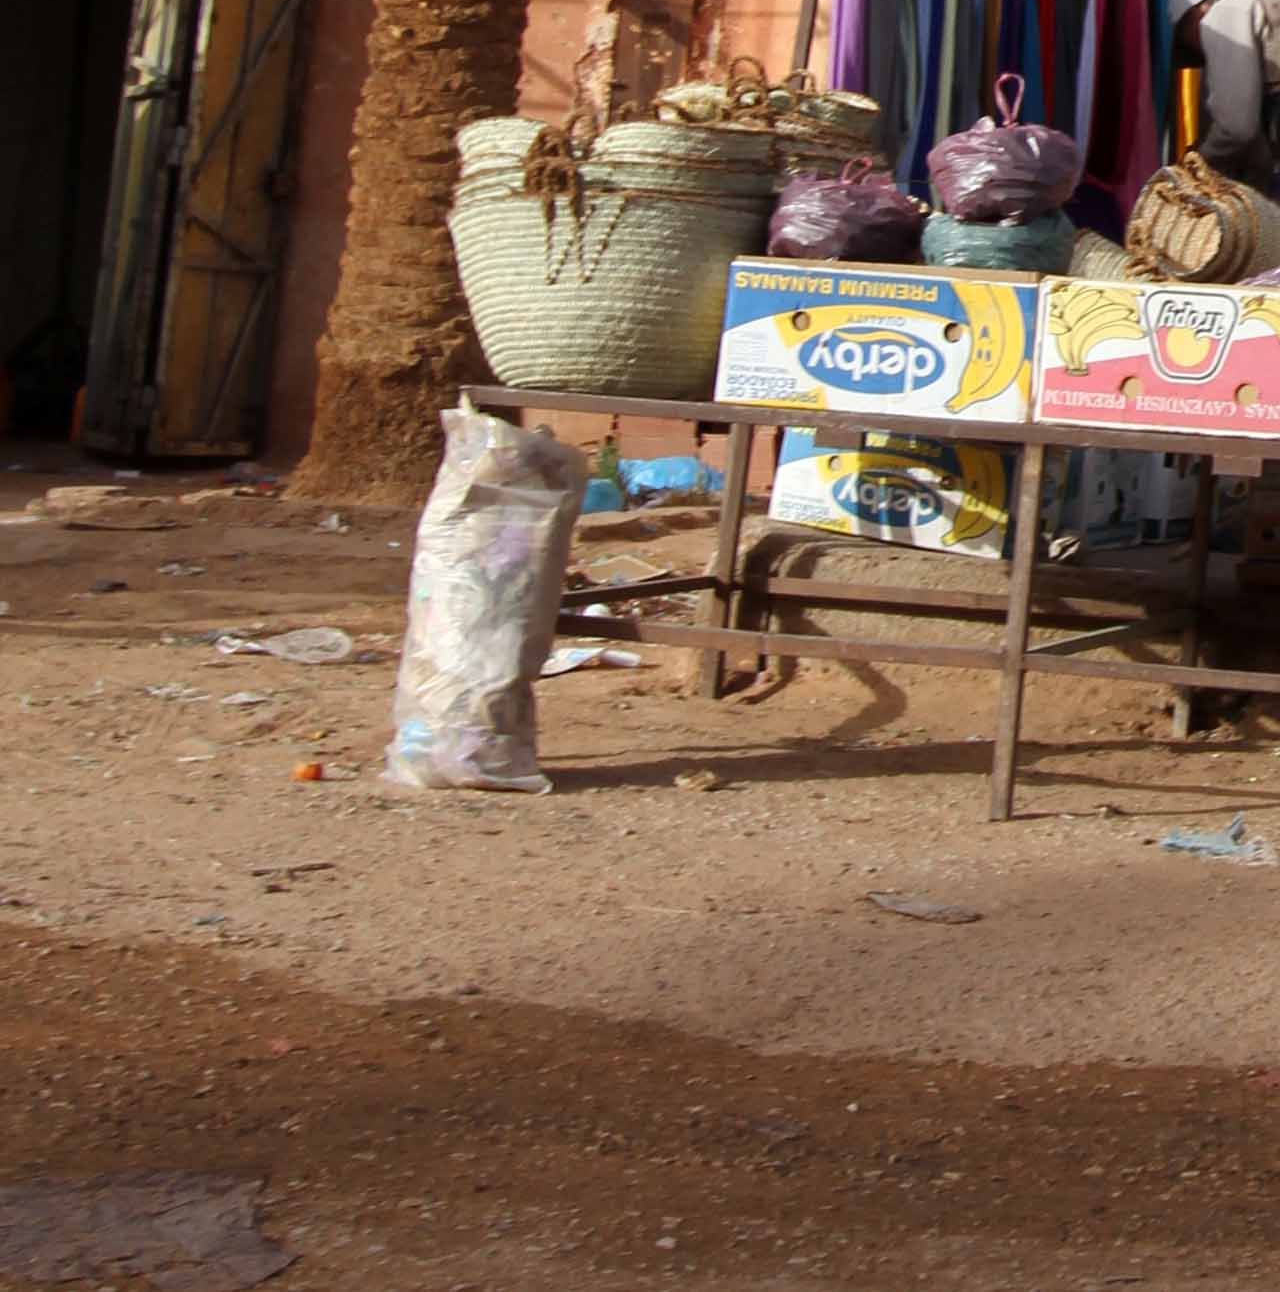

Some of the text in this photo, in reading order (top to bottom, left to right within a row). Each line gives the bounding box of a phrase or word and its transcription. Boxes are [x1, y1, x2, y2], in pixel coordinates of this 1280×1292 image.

[735, 270, 938, 303] PREMIUM BANANAS
[1158, 299, 1226, 337] Tropy
[807, 330, 937, 394] derby
[1043, 389, 1127, 410] PREMIUM
[1136, 393, 1237, 418] CAVENDISH
[837, 471, 937, 527] derby
